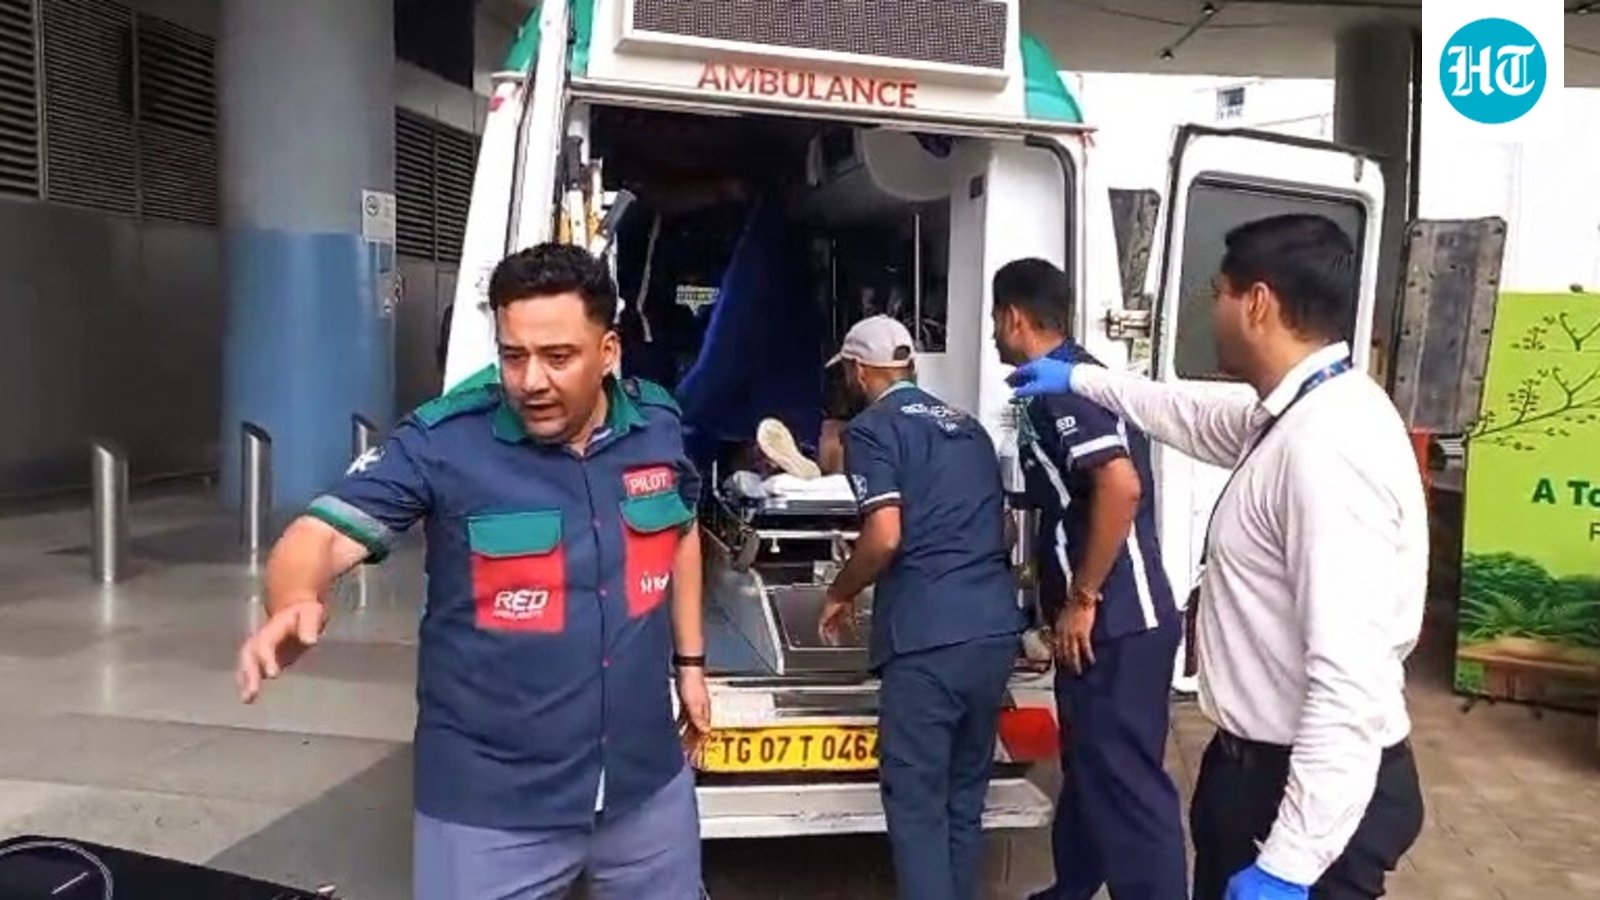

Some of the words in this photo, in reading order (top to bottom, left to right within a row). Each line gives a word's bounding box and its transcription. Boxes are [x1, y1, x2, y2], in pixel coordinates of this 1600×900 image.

[698, 60, 917, 108] AMBULANCE
[629, 471, 668, 494] PILOT
[1532, 478, 1556, 504] A
[494, 589, 549, 611] RED
[720, 736, 750, 764] TG
[760, 736, 791, 763] 07
